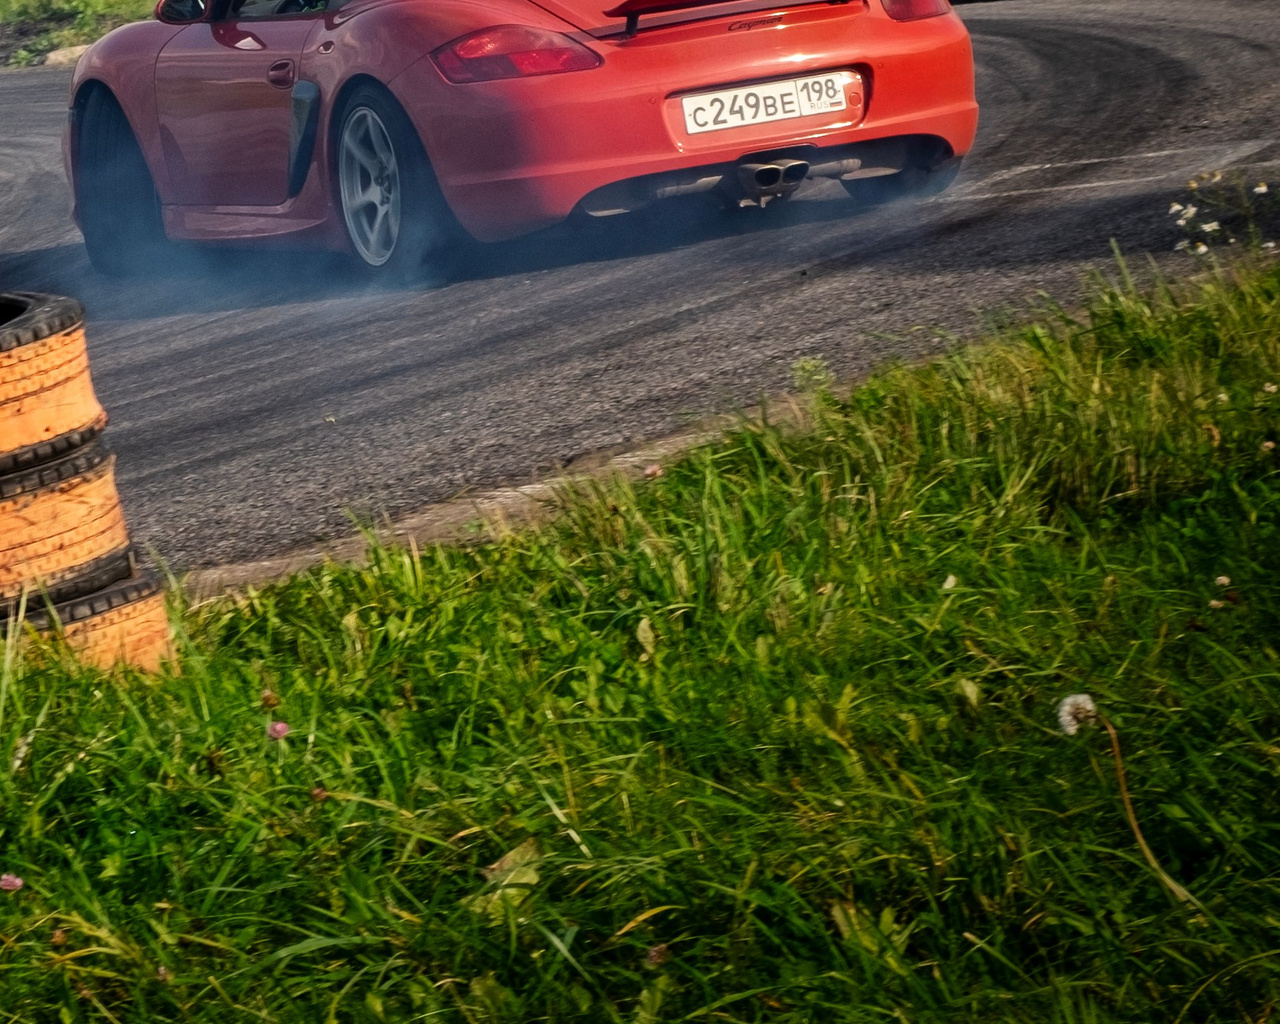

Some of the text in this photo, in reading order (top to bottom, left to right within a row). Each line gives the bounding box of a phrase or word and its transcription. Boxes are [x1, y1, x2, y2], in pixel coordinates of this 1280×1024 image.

[727, 16, 783, 32] Cayman
[692, 78, 837, 128] С249ВЕ 198
[809, 101, 830, 111] RUS
